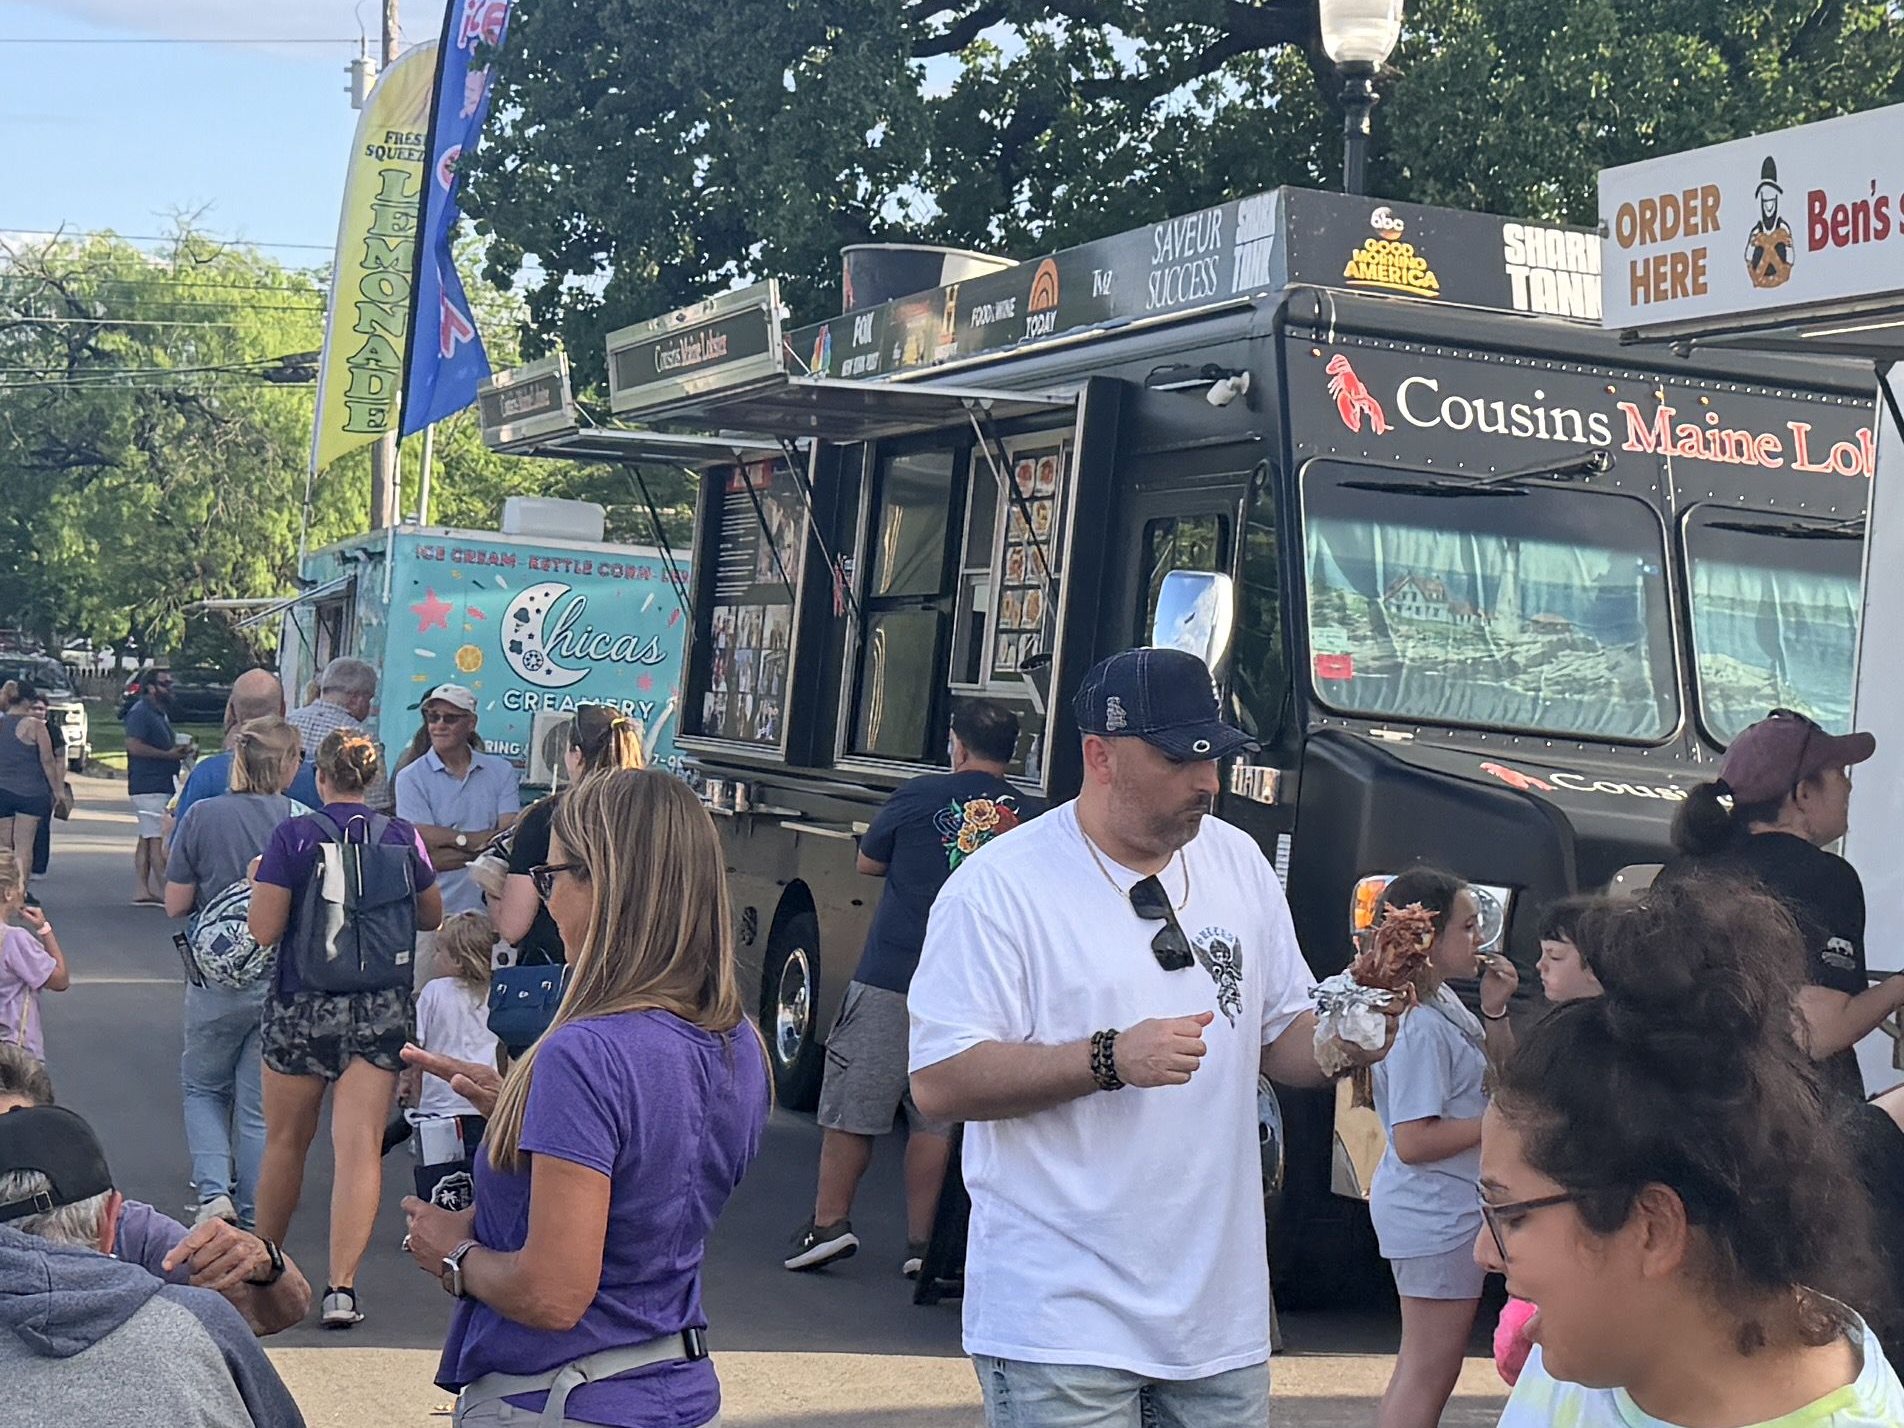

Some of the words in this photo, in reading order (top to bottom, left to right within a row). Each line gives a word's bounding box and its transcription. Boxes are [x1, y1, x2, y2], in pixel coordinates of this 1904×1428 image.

[1152, 208, 1223, 266] SAVEUR
[1614, 184, 1721, 250] ORDER
[1806, 178, 1891, 253] Ben's
[1343, 260, 1441, 290] AMERICA
[1364, 238, 1415, 259] GOOD
[1146, 255, 1220, 310] SUCCESS
[1629, 247, 1709, 307] HERE
[1026, 310, 1057, 339] TODAY
[1396, 376, 1612, 447] Cousins
[1617, 401, 1784, 469] Maine
[450, 547, 517, 569] CREAM
[528, 554, 593, 575] KETTLE
[503, 689, 655, 721] CREARY
